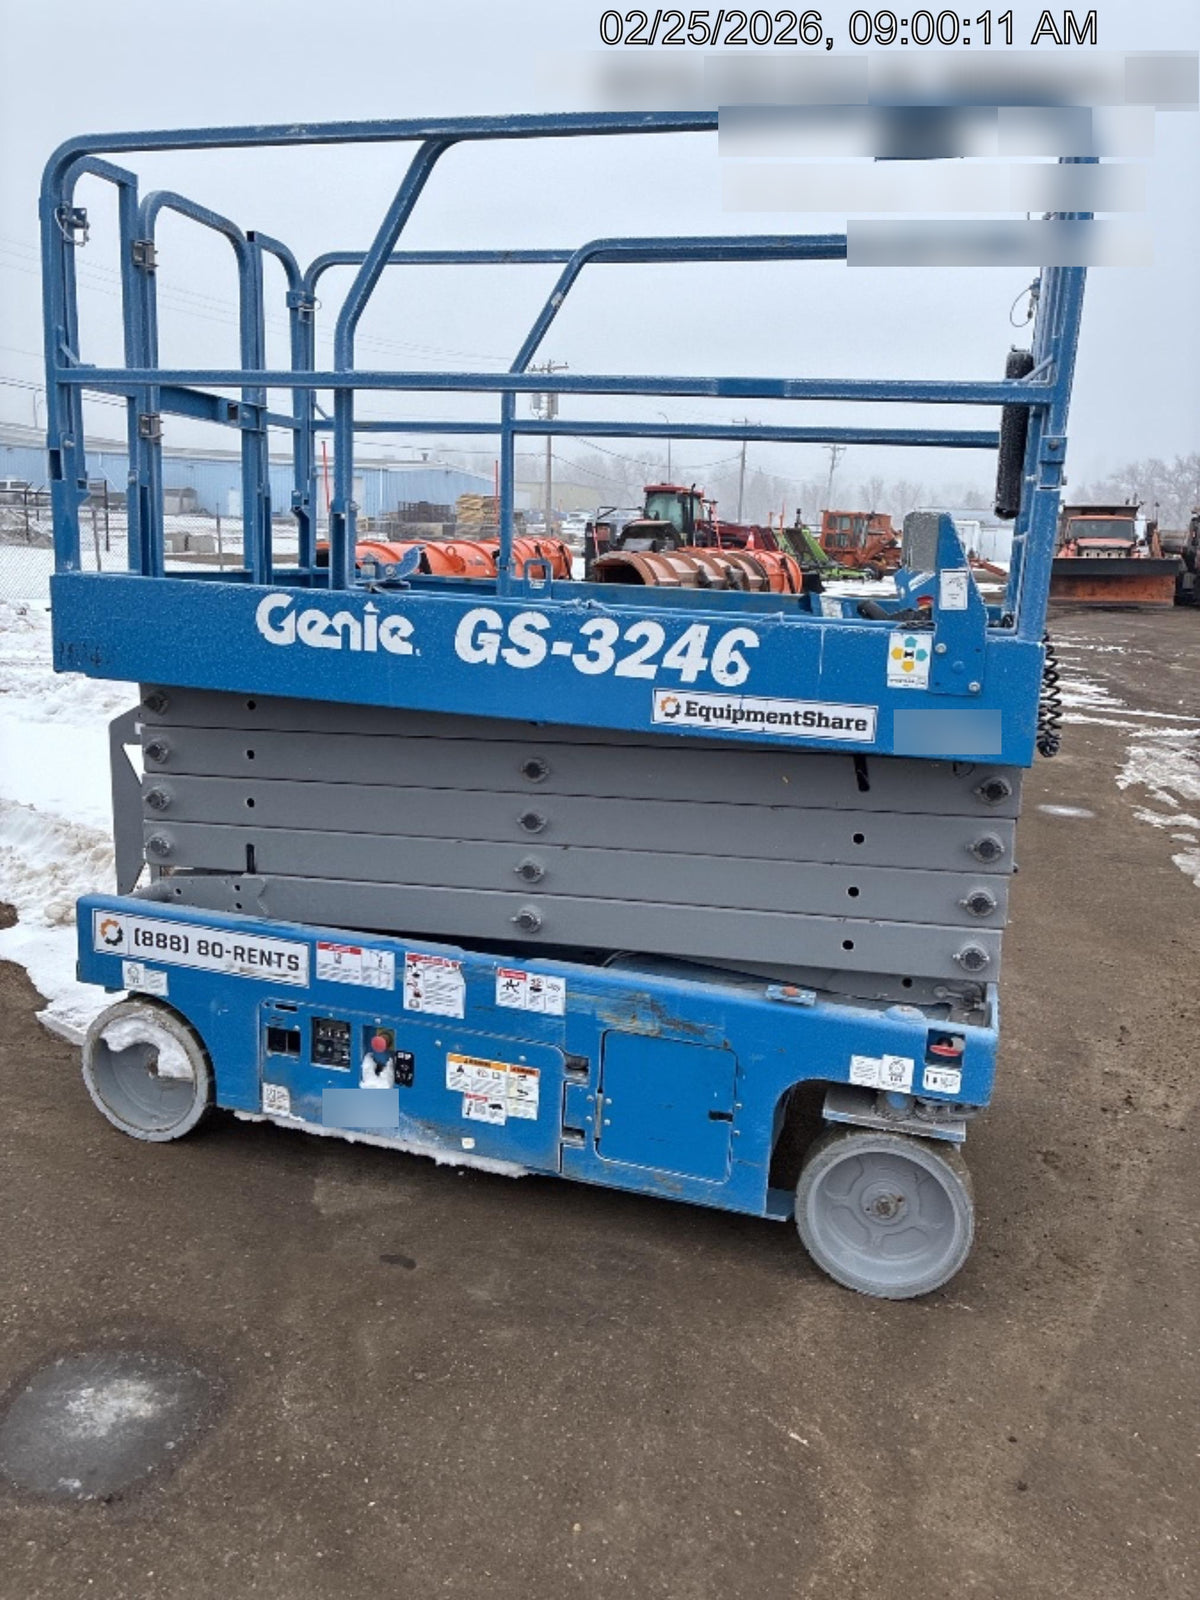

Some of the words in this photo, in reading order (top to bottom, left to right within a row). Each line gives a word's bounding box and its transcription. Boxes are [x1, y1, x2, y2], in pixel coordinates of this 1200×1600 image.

[255, 593, 416, 656] Genie
[454, 608, 760, 688] GS-3246
[683, 700, 868, 733] EquipmentShare
[134, 927, 190, 955] (888)
[196, 939, 300, 973] 80-RENTS
